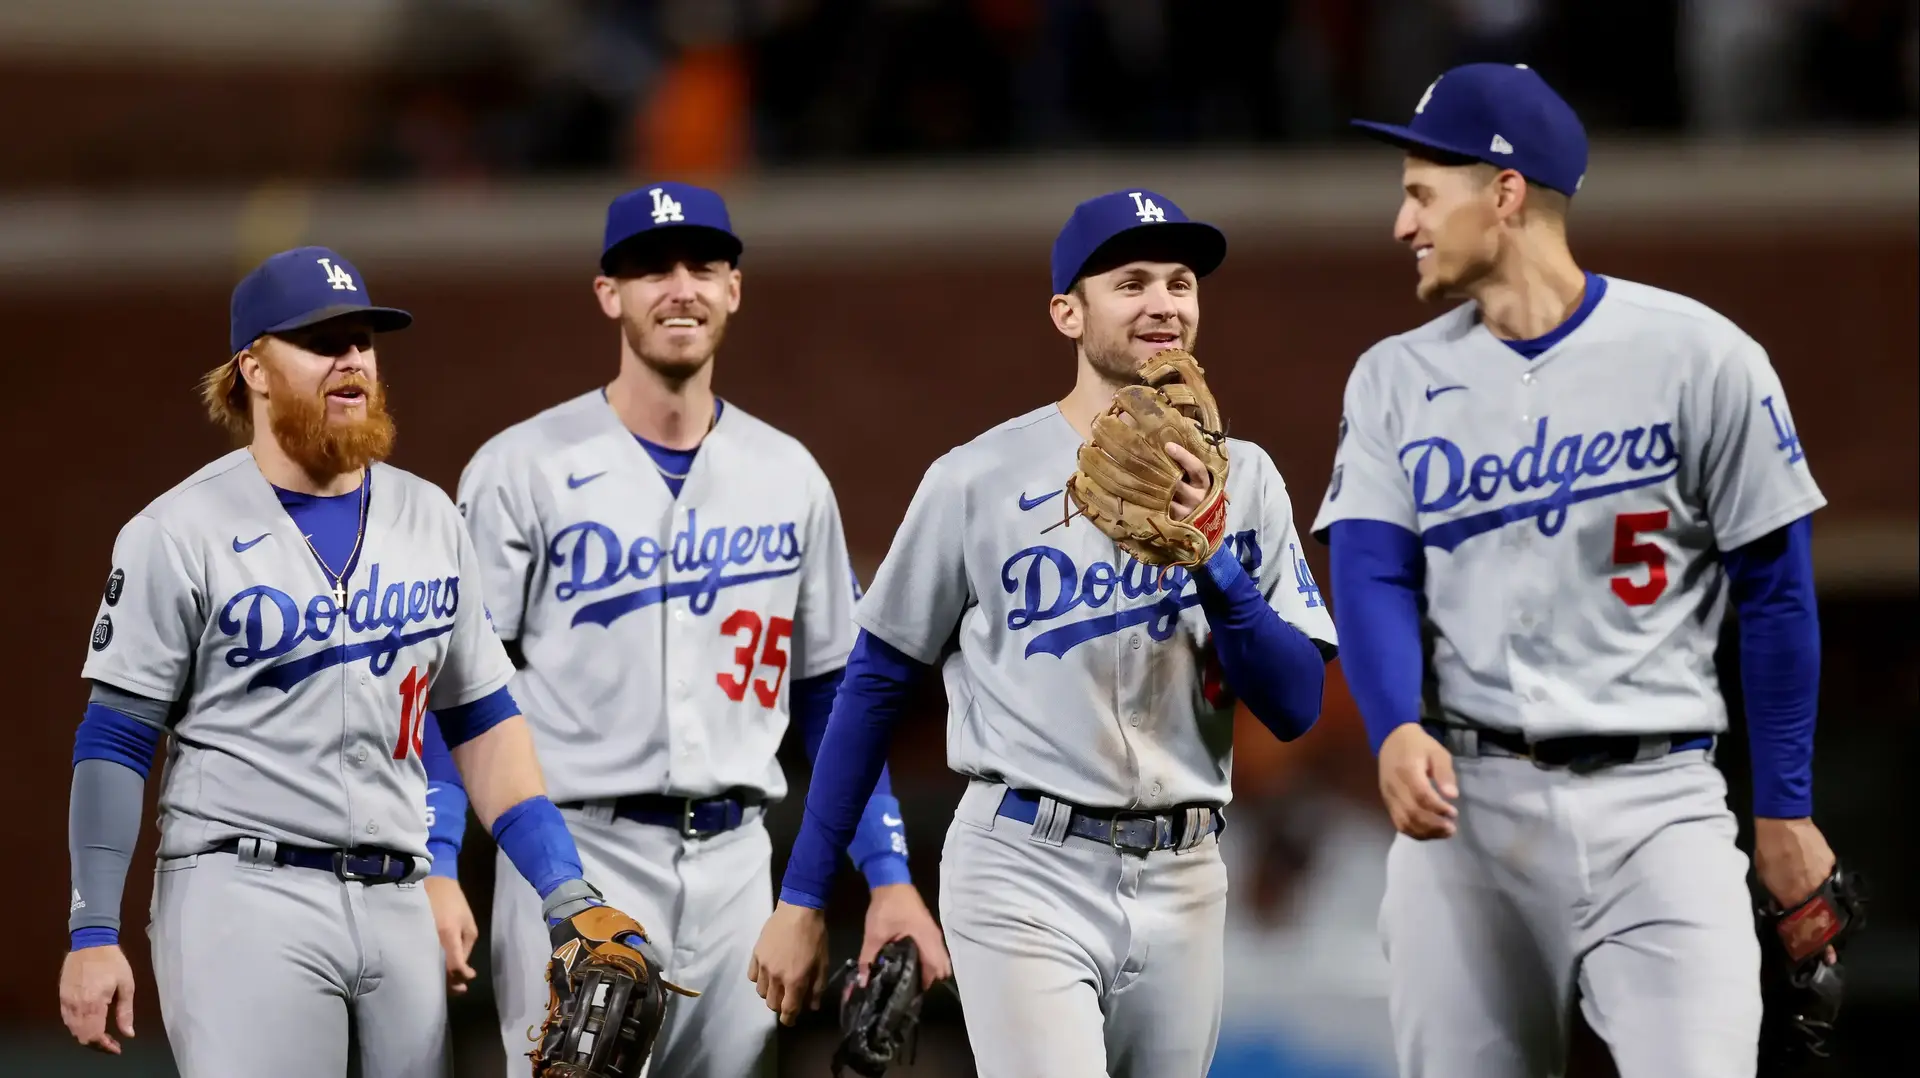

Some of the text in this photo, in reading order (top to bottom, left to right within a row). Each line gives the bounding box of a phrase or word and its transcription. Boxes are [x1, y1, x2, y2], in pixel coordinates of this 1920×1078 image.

[648, 188, 685, 224] LA
[1128, 192, 1168, 223] LA
[316, 258, 358, 291] LA
[1399, 415, 1683, 537] Dodgers
[550, 507, 803, 617] Dodgers
[1610, 509, 1671, 607] 5
[218, 562, 460, 678] Dodgers
[716, 608, 794, 710] 35
